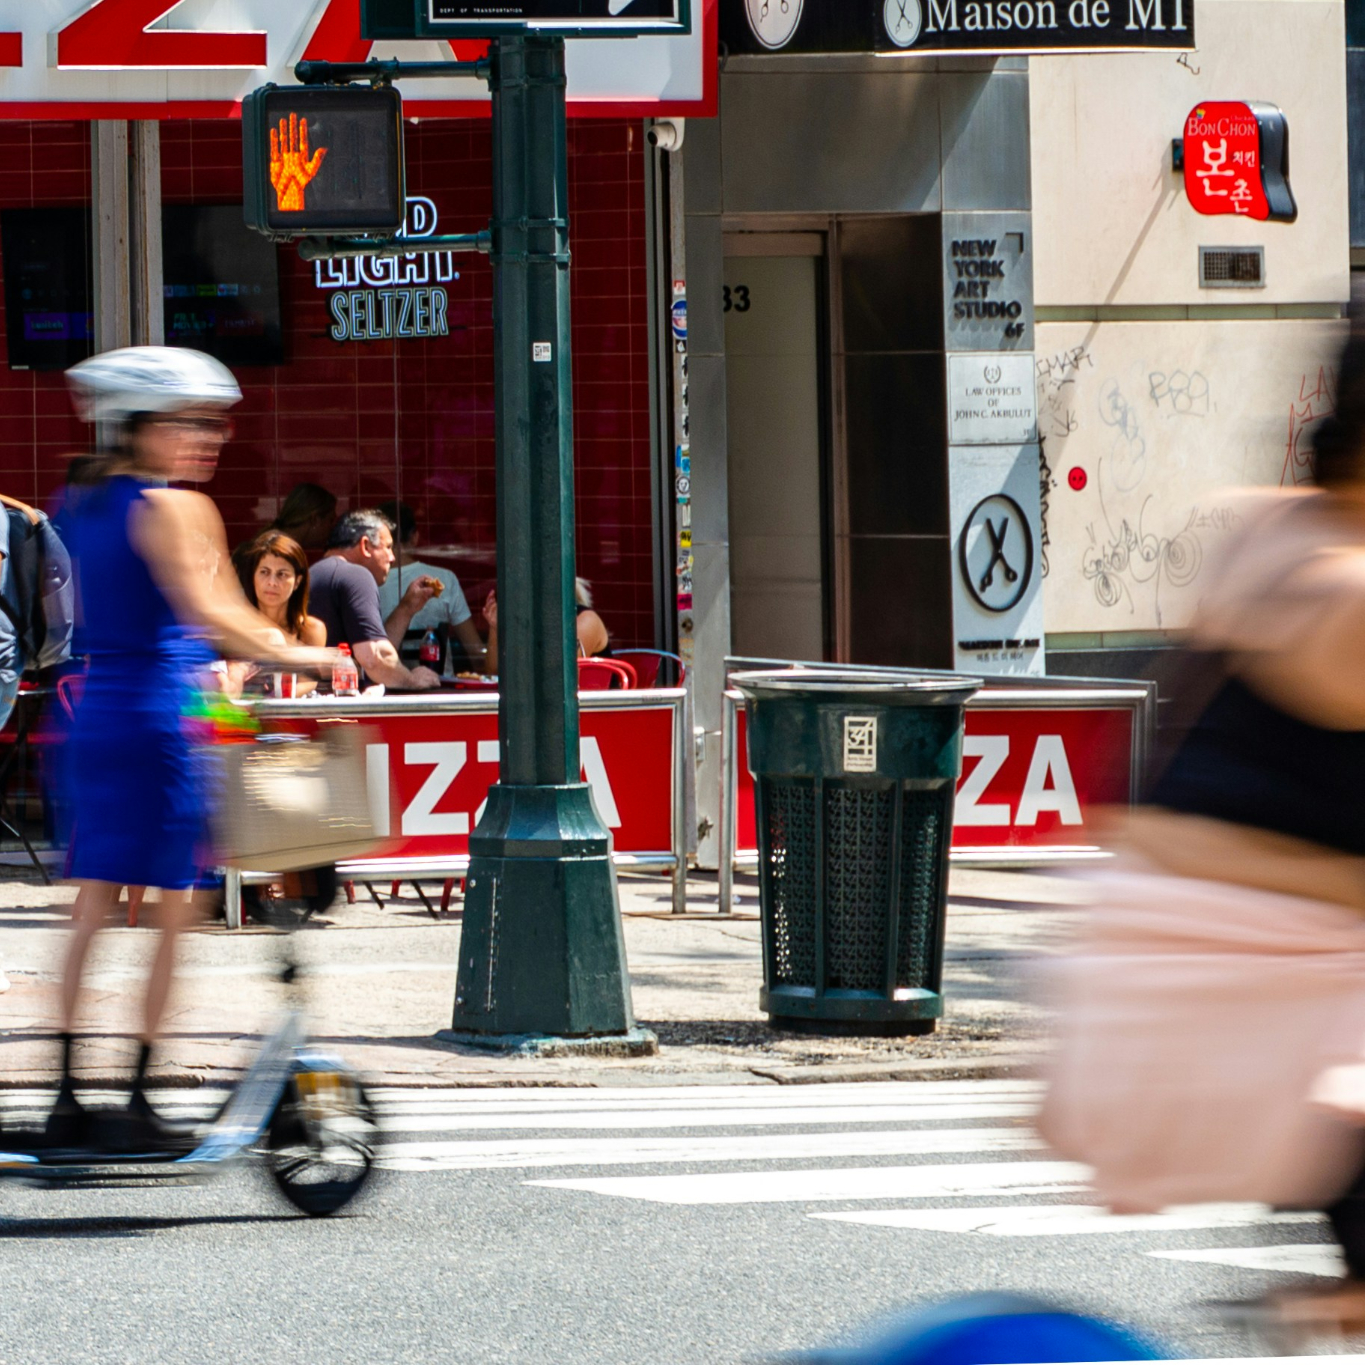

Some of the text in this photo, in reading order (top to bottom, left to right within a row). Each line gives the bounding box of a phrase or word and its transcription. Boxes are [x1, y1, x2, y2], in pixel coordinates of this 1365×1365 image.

[952, 240, 996, 257] NEW
[954, 260, 1004, 278] YORK
[954, 280, 990, 298] ART
[331, 287, 449, 342] SELTZER
[954, 301, 1022, 319] STUDIO
[965, 387, 1021, 396] LAW OFFICES
[988, 399, 999, 407] OF
[954, 410, 980, 421] JOHN
[990, 409, 1032, 418] AKBULUT
